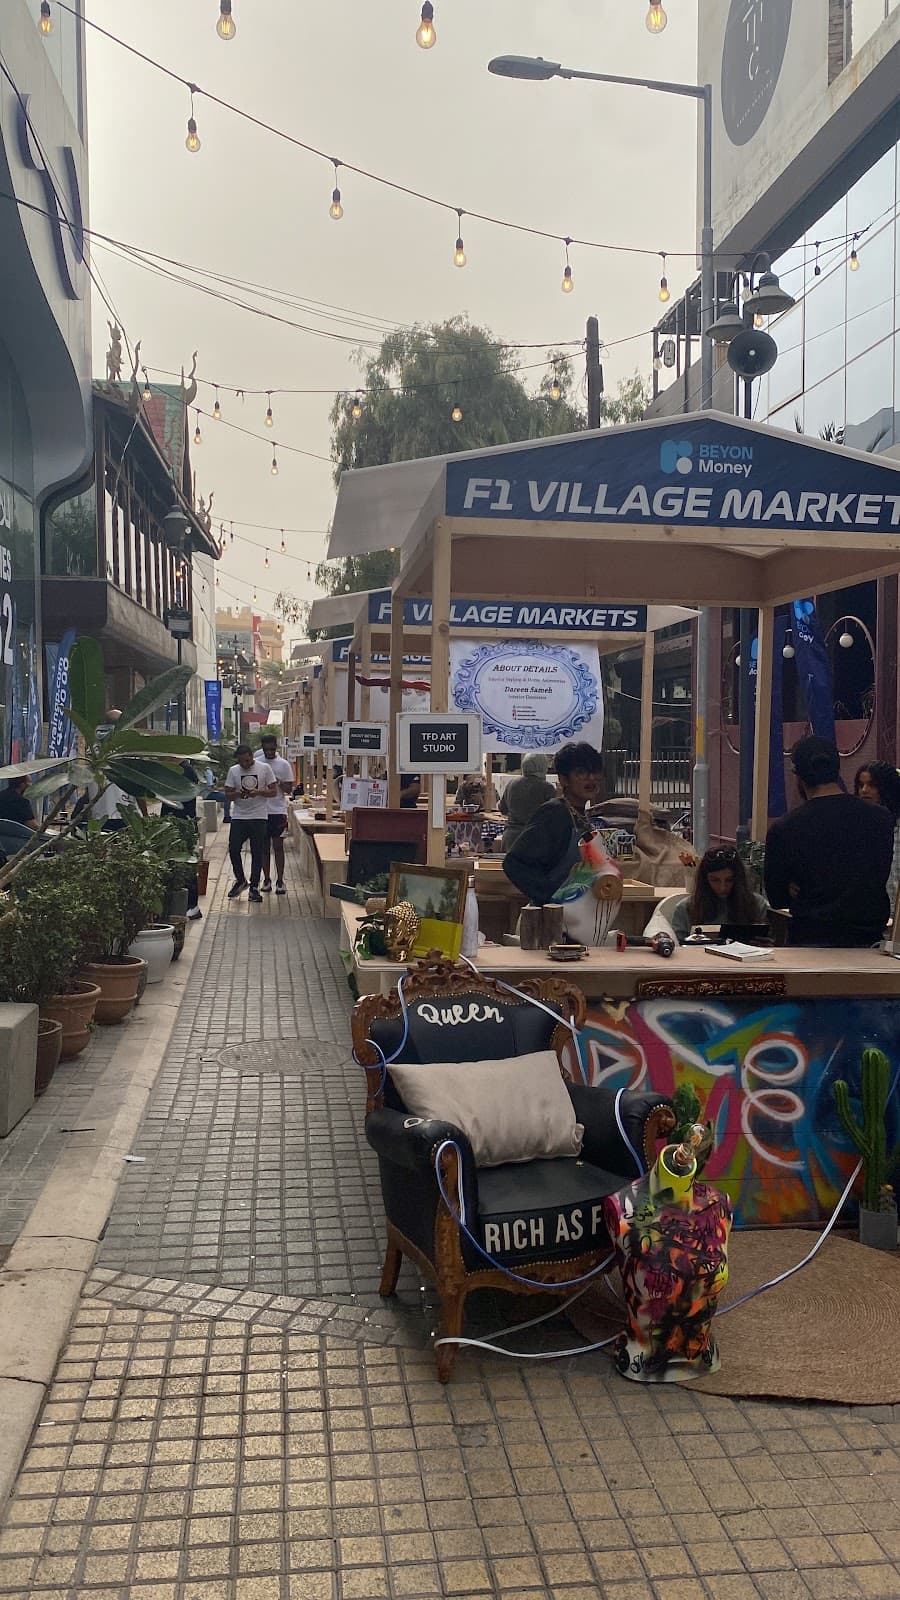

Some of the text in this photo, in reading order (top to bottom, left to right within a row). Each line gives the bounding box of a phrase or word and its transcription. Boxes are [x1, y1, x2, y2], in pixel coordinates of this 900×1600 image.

[700, 444, 753, 460] BEYON
[699, 459, 753, 478] Money
[463, 477, 900, 526] F1 VILLAGE MARKET
[412, 603, 513, 624] VILAGE
[516, 607, 639, 628] MARKETS
[492, 664, 558, 673] ABOUT DETAILS
[529, 686, 553, 694] Sameh
[421, 732, 457, 741] TFD ART
[422, 744, 456, 753] STUDIO
[417, 1002, 504, 1026] Queen
[484, 1217, 545, 1254] RICH
[555, 1208, 584, 1244] AS
